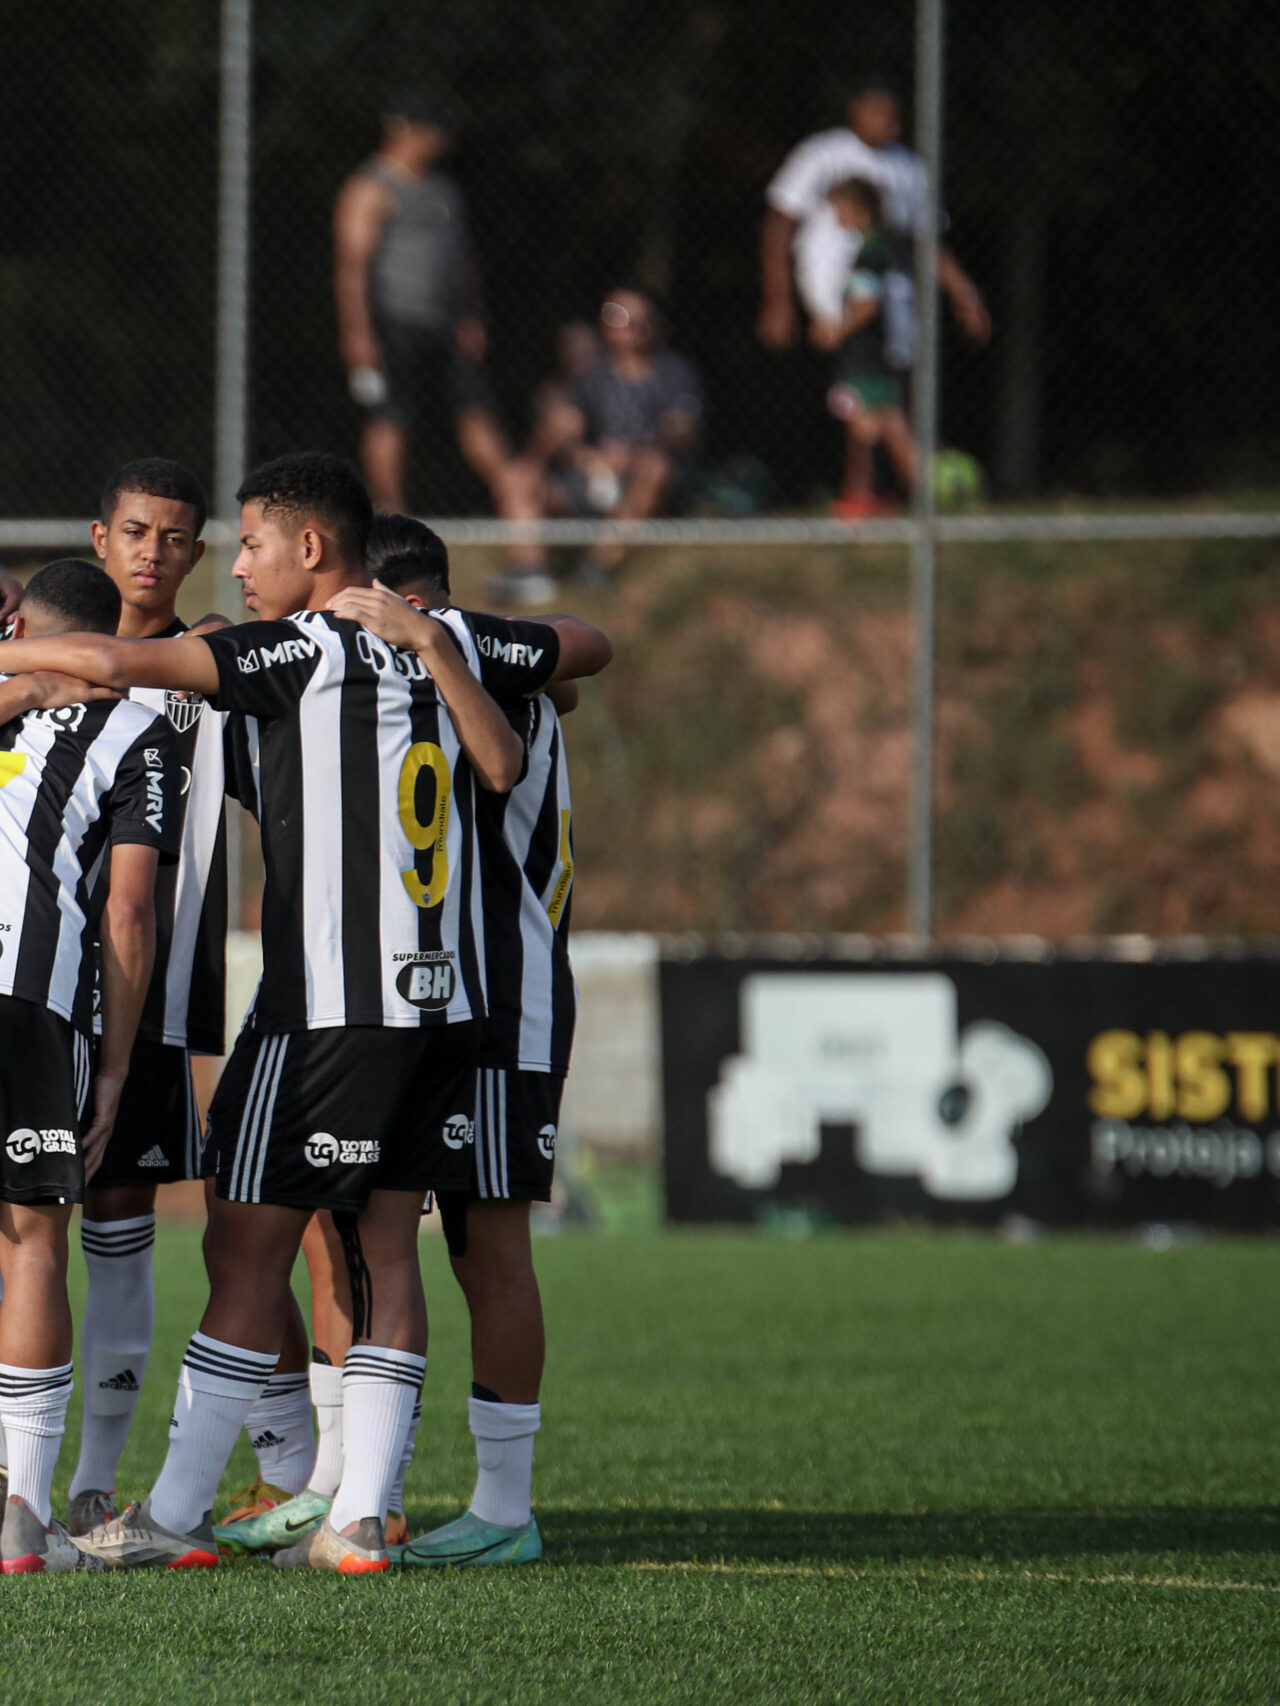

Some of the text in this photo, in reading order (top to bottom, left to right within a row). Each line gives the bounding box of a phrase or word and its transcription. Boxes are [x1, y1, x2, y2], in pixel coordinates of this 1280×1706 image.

[260, 640, 316, 668] MRV
[492, 638, 544, 668] MRV
[144, 770, 165, 834] MRV
[398, 741, 451, 908] 9
[408, 965, 452, 1000] BH
[1087, 1030, 1280, 1123] SIST
[39, 1129, 76, 1143] TOTAL
[42, 1141, 77, 1155] GRASS
[340, 1140, 381, 1152] TOTAL
[137, 1159, 170, 1167] adidas
[339, 1151, 380, 1164] GRASS
